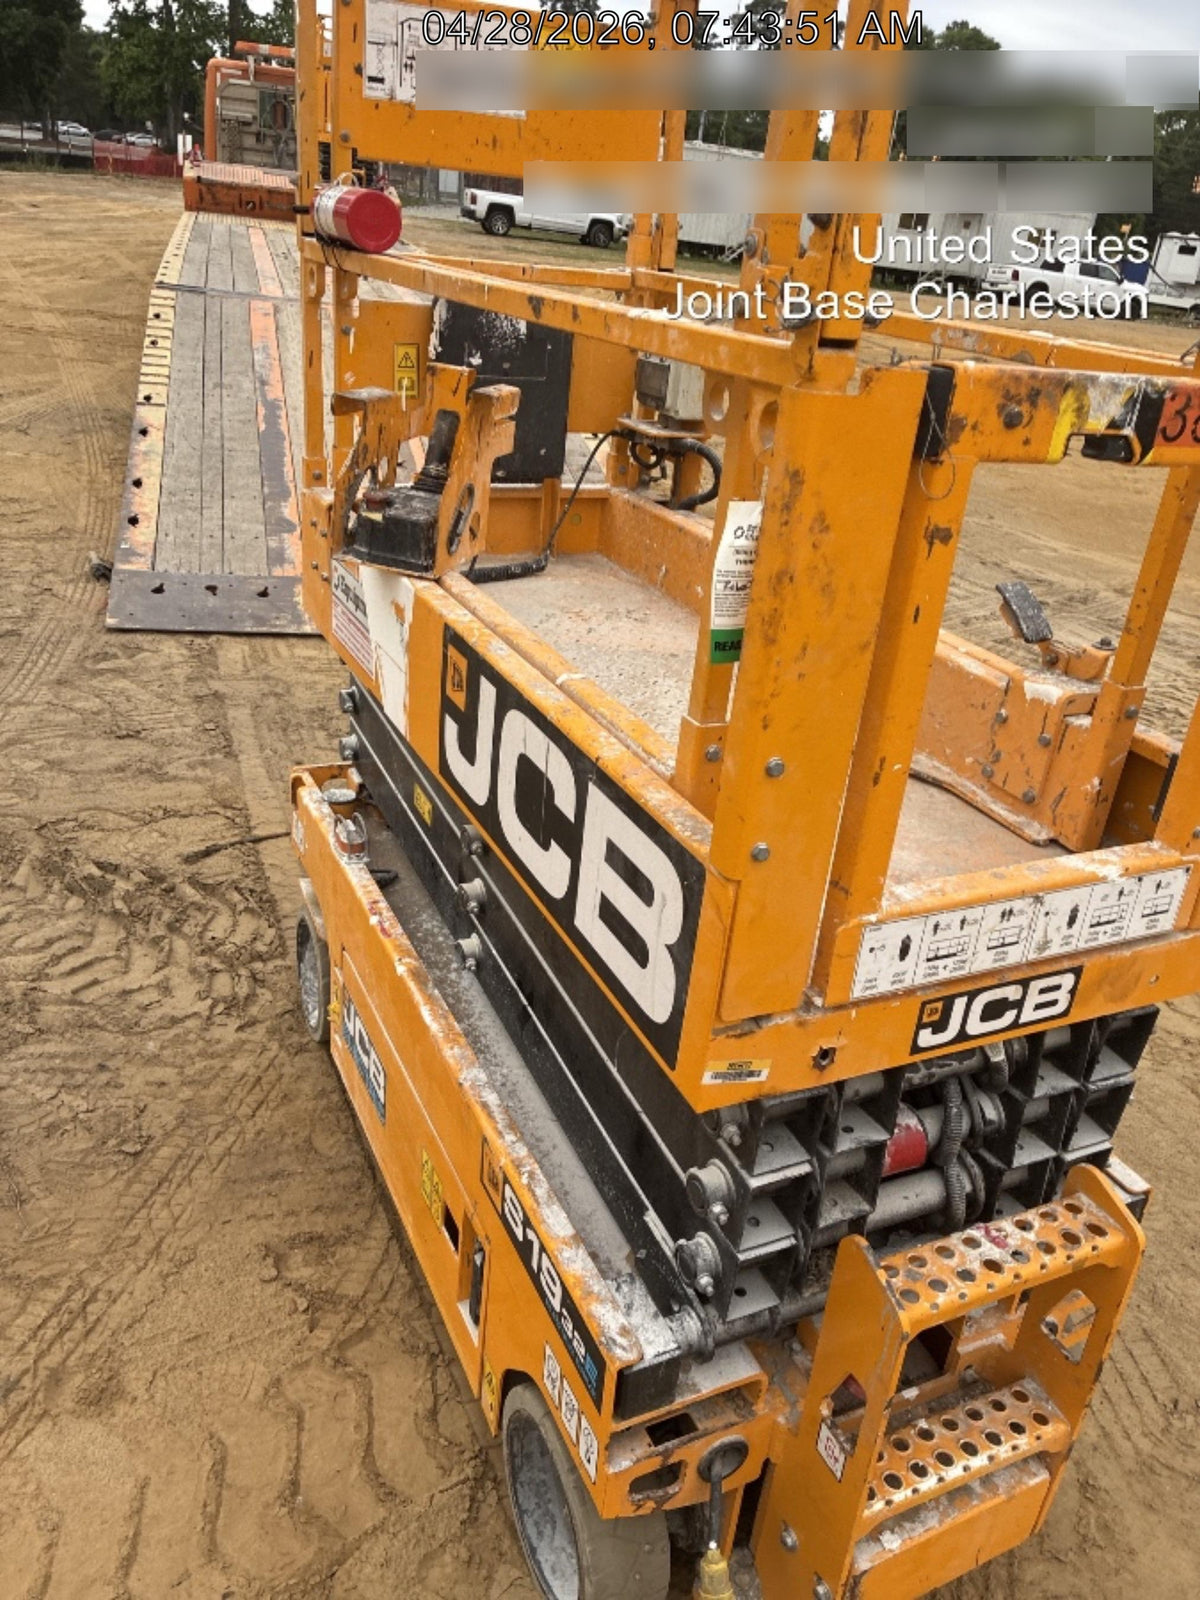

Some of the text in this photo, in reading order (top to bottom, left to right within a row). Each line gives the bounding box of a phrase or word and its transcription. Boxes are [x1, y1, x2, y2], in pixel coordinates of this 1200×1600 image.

[444, 674, 684, 1024] JCB
[343, 1003, 386, 1105] JCB
[917, 972, 1076, 1048] JCB
